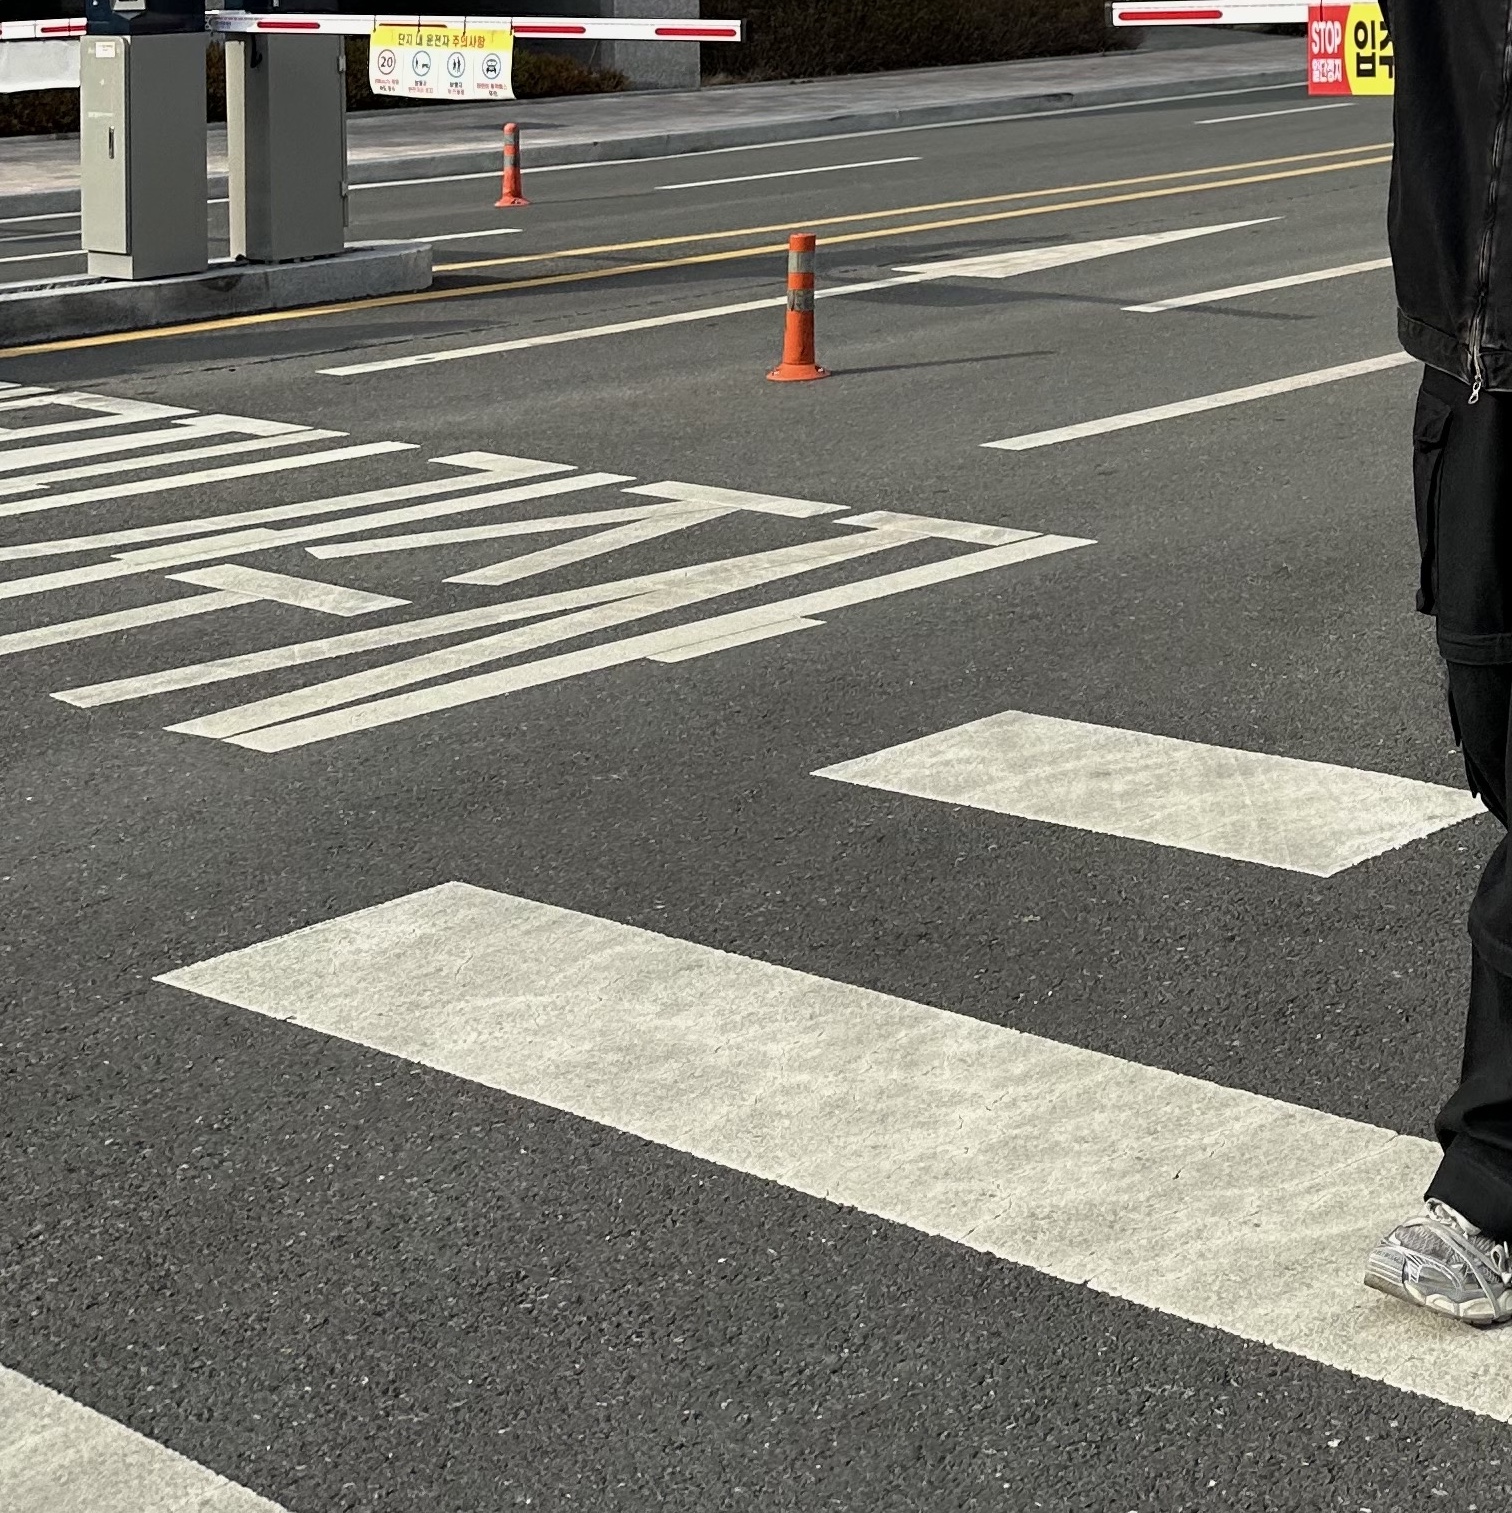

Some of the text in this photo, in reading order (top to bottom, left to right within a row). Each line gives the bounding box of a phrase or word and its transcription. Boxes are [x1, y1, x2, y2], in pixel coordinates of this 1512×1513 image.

[398, 33, 413, 46] 단지
[426, 34, 450, 47] 운전자
[452, 34, 486, 48] 주의사항
[1311, 20, 1342, 55] STOP
[380, 56, 394, 68] 20
[1312, 58, 1342, 83] 일단정지
